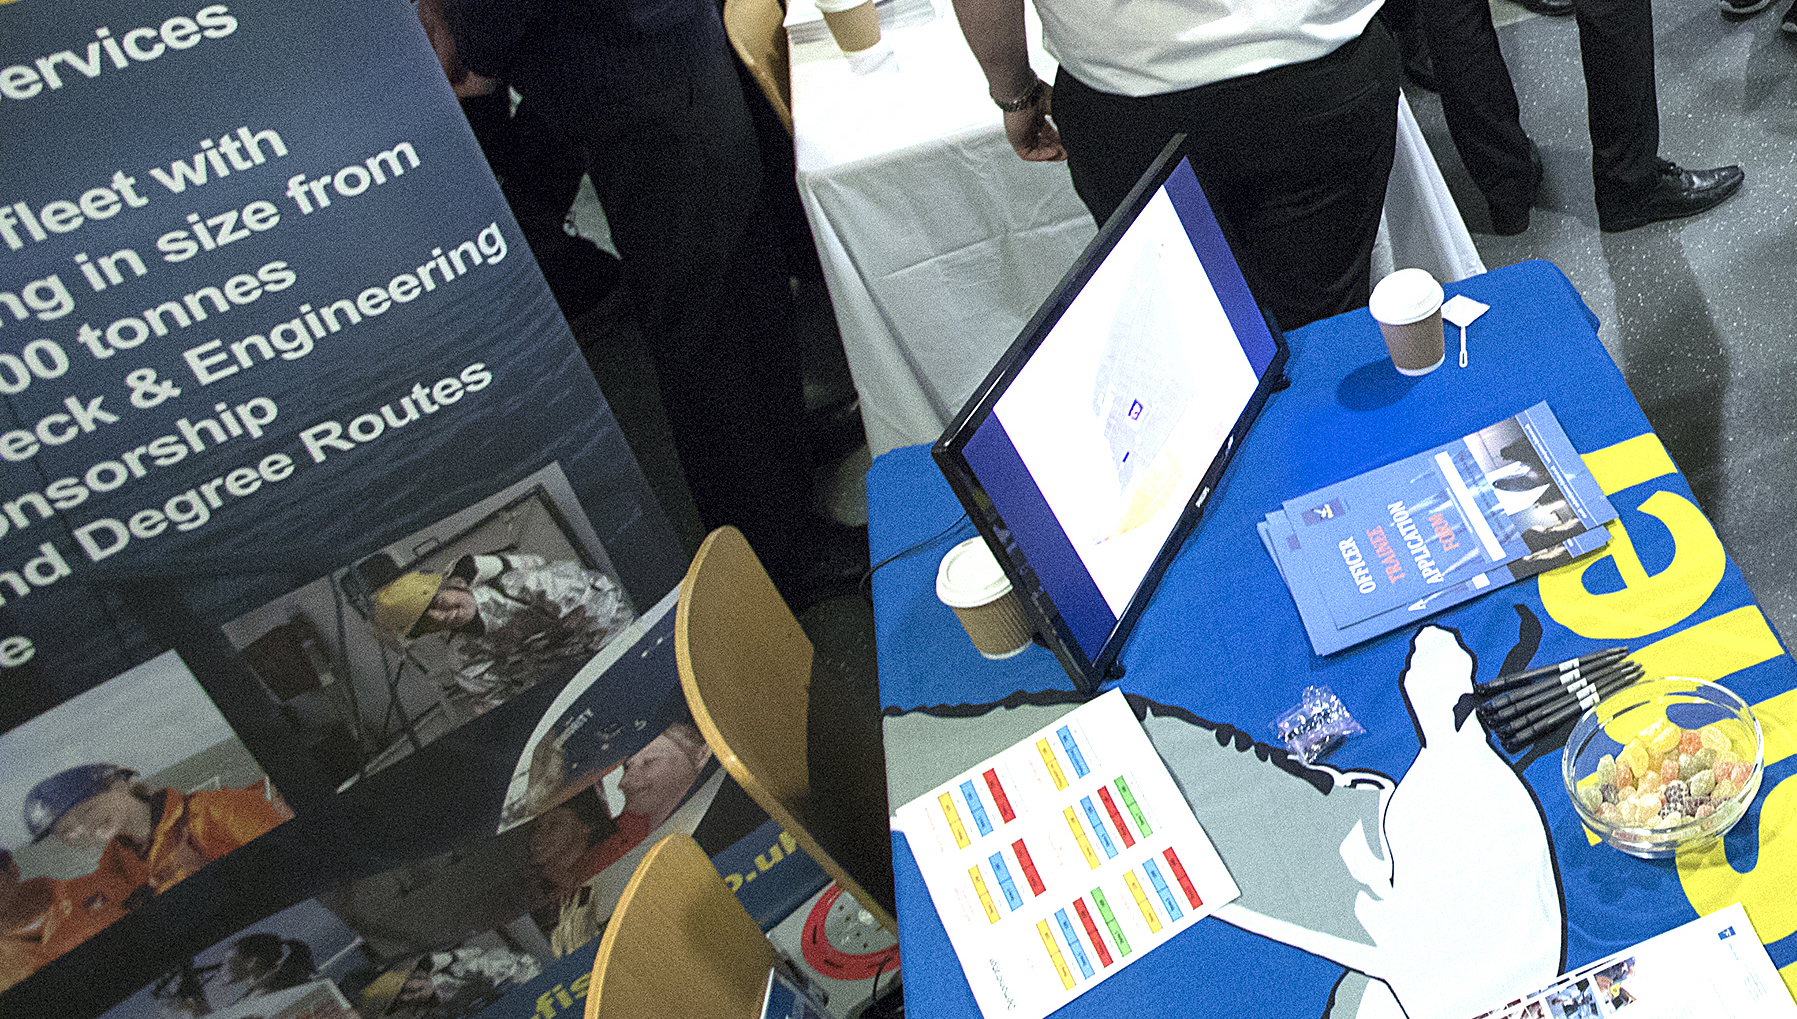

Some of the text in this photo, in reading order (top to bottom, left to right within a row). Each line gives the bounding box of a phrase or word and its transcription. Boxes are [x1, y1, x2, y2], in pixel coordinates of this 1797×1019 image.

[0, 4, 238, 101] ervices
[0, 126, 288, 251] fleet with
[75, 248, 146, 290] in
[157, 199, 280, 263] size
[286, 141, 421, 215] from
[0, 222, 509, 462] eck & Engineering
[77, 258, 296, 360] tonnes
[0, 395, 278, 536] nsorship
[73, 452, 295, 562] Degree
[300, 361, 494, 465] Routes
[1338, 535, 1376, 595] OFFICER
[1365, 524, 1406, 585] TRAINEE
[1387, 499, 1446, 586] APPLICATION
[1427, 512, 1461, 553] FORM
